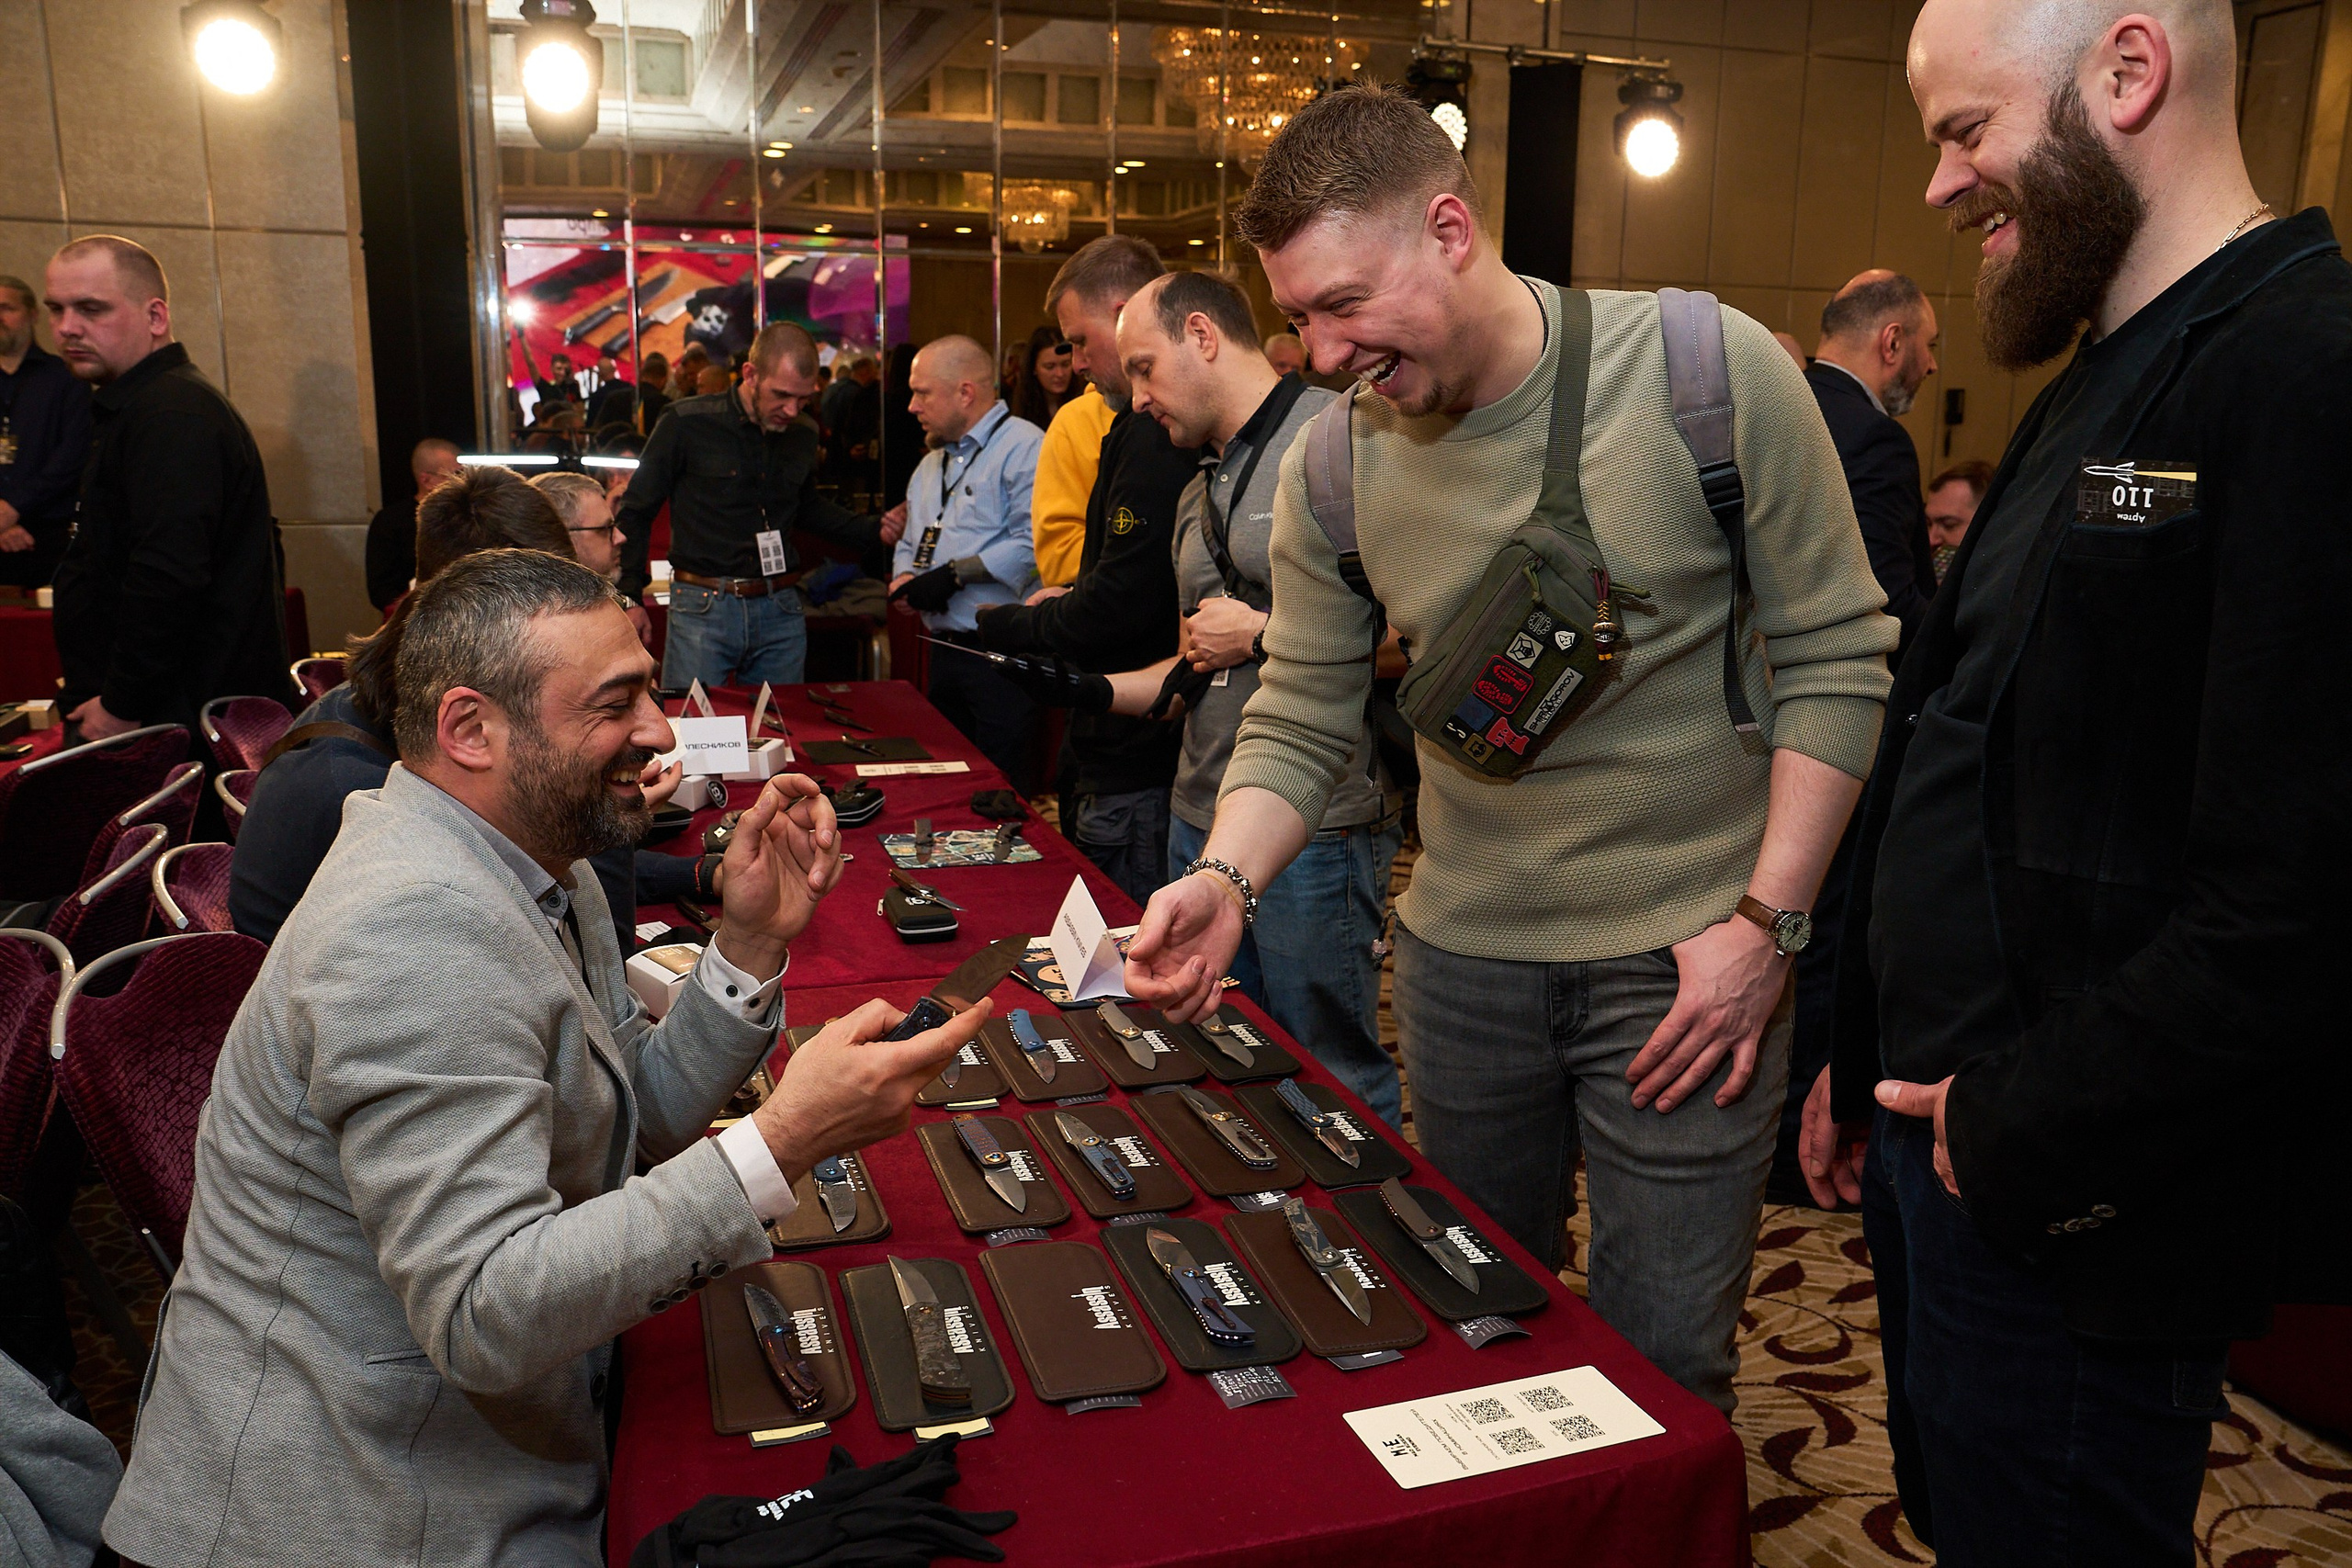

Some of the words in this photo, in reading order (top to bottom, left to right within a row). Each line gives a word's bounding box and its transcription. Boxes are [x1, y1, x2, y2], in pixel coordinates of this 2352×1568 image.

[2112, 485, 2154, 508] 110
[2117, 513, 2146, 524] Артем
[1109, 1136, 1151, 1167] Assassin
[1446, 1225, 1492, 1264] Assassin
[1204, 1261, 1250, 1306] Assassin
[1226, 1261, 1261, 1304] KNIVES
[1070, 1285, 1122, 1329] Assassin
[1103, 1285, 1133, 1328] KNIVES
[789, 1307, 822, 1355] Assassin
[817, 1306, 835, 1353] KNIVES
[944, 1305, 975, 1354] Assassin
[961, 1305, 987, 1352] KNIVES
